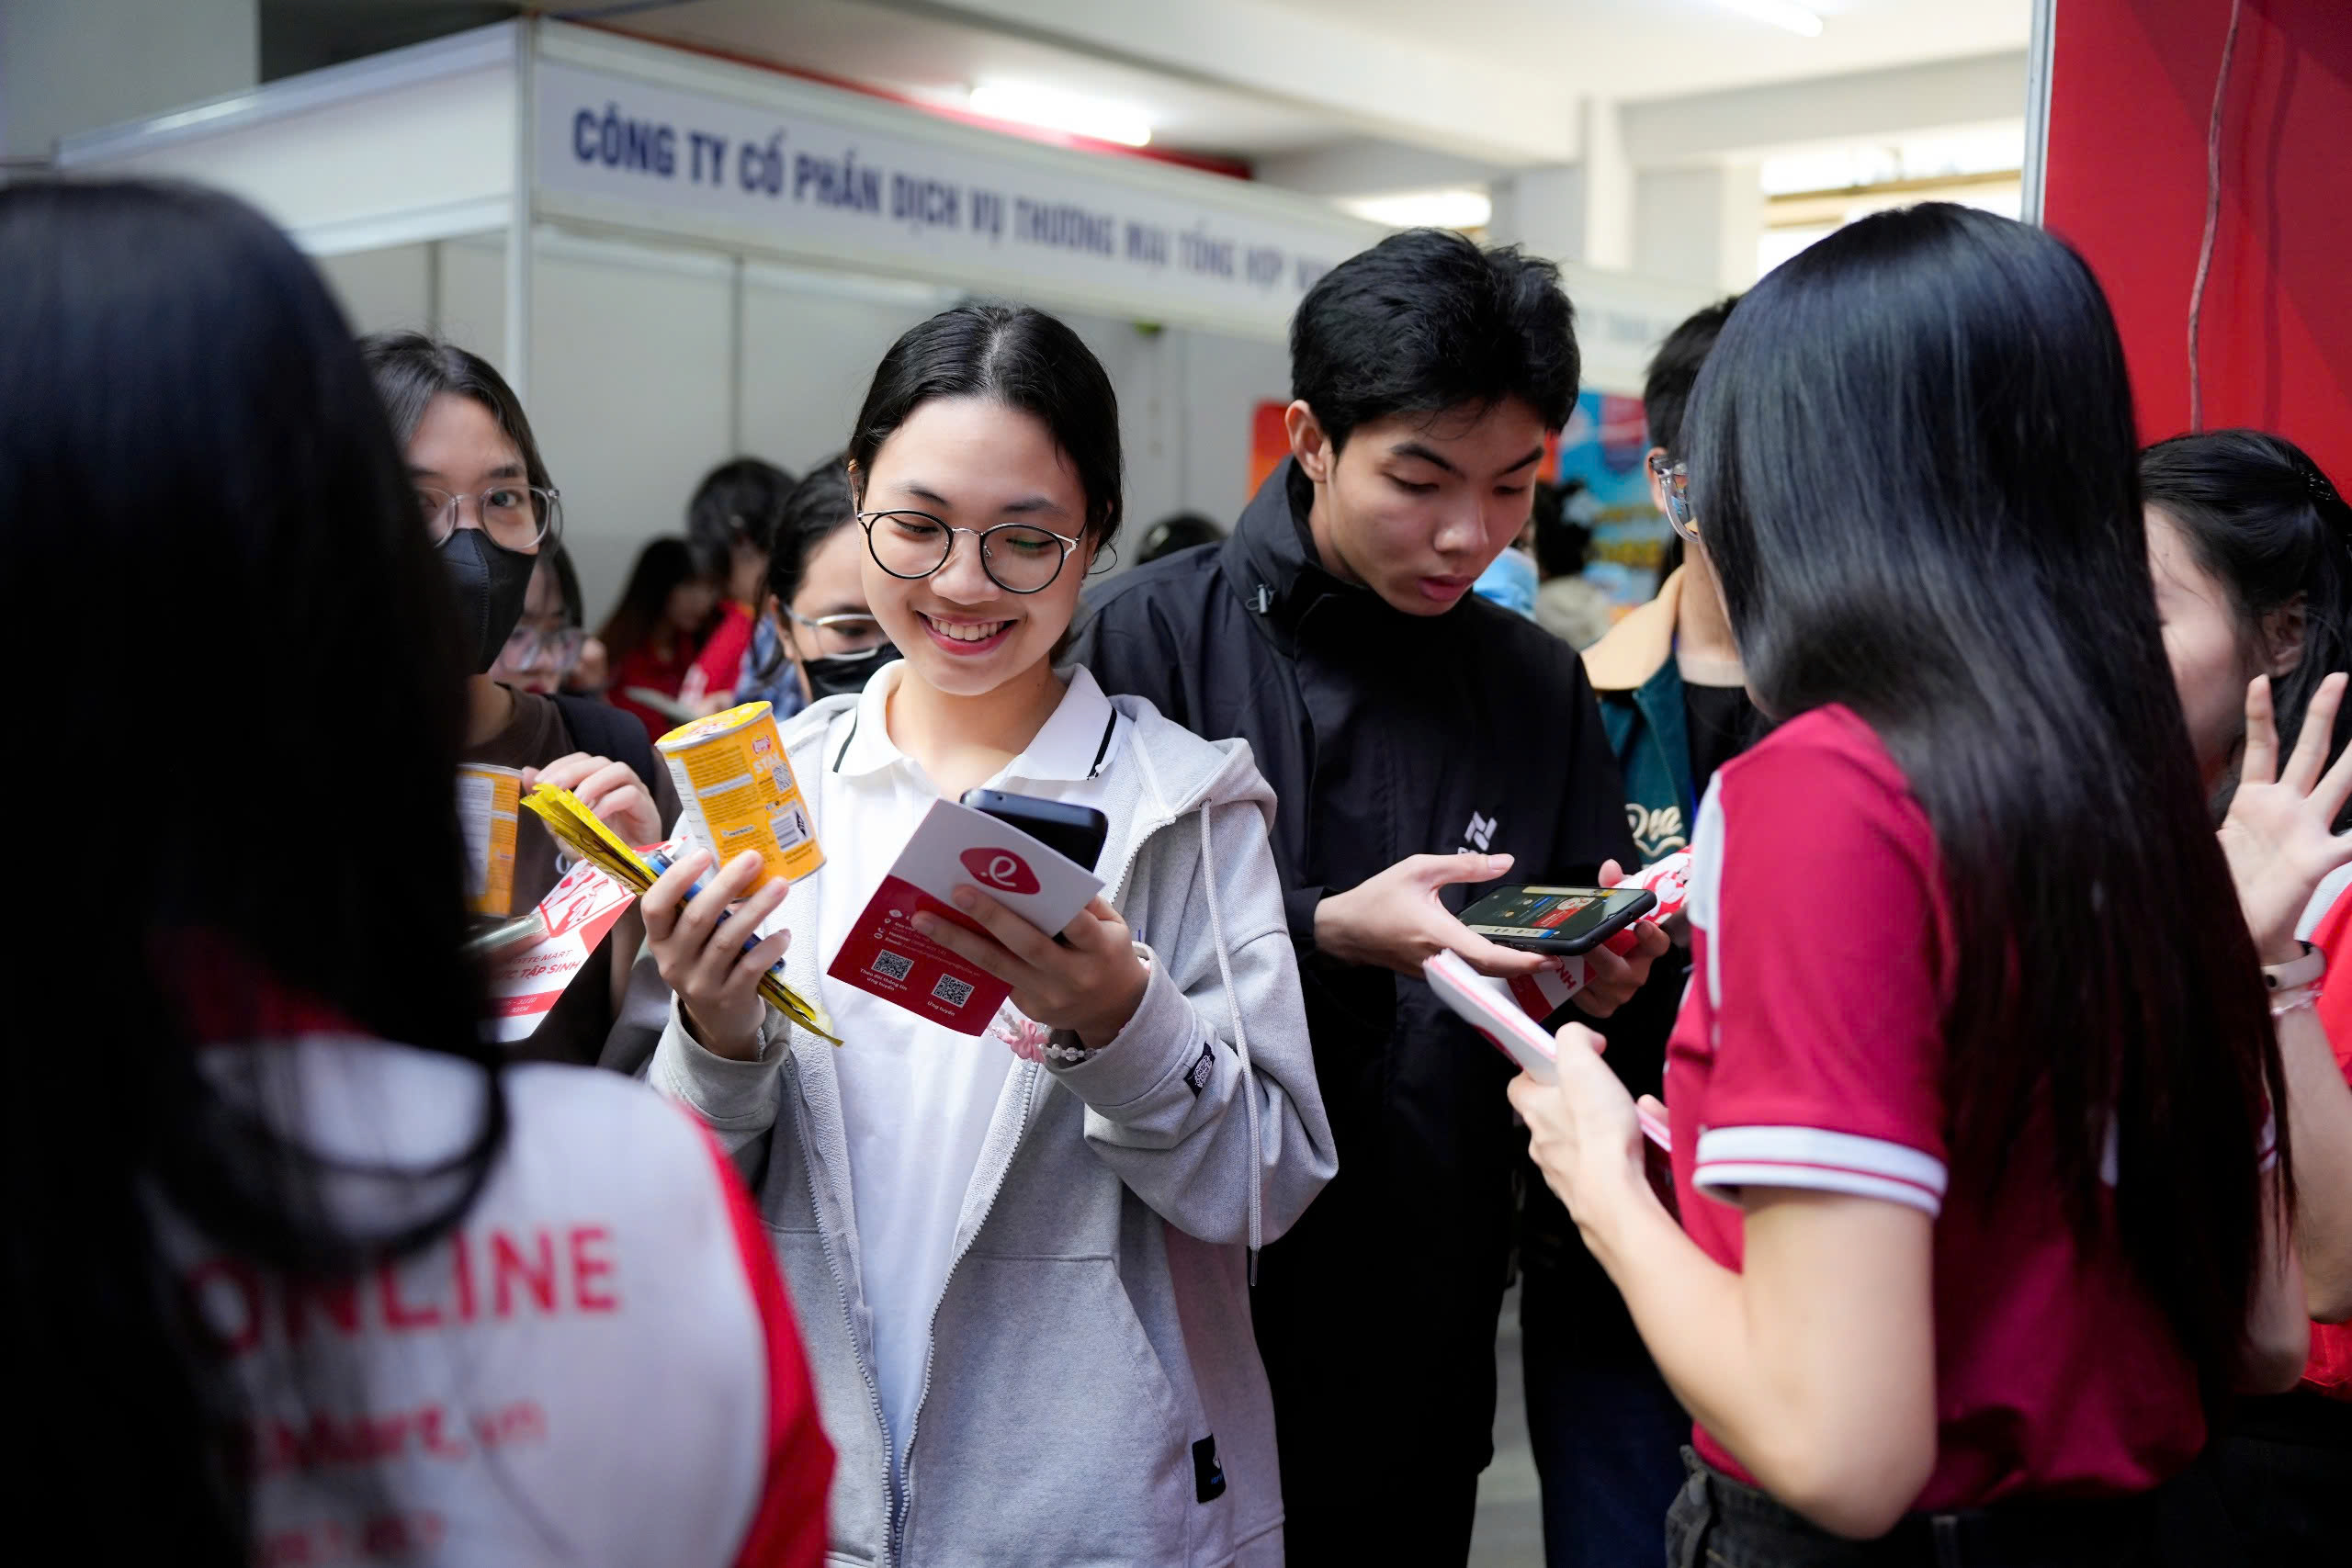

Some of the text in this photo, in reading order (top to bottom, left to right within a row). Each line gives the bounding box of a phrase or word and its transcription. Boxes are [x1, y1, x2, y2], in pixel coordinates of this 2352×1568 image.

[574, 101, 674, 178] CÔNG
[690, 130, 727, 186] TY
[541, 950, 573, 962] MART
[520, 964, 547, 980] TẬP
[547, 960, 581, 975] SINH
[860, 968, 873, 977] Theo
[182, 1223, 619, 1361] ONLINE
